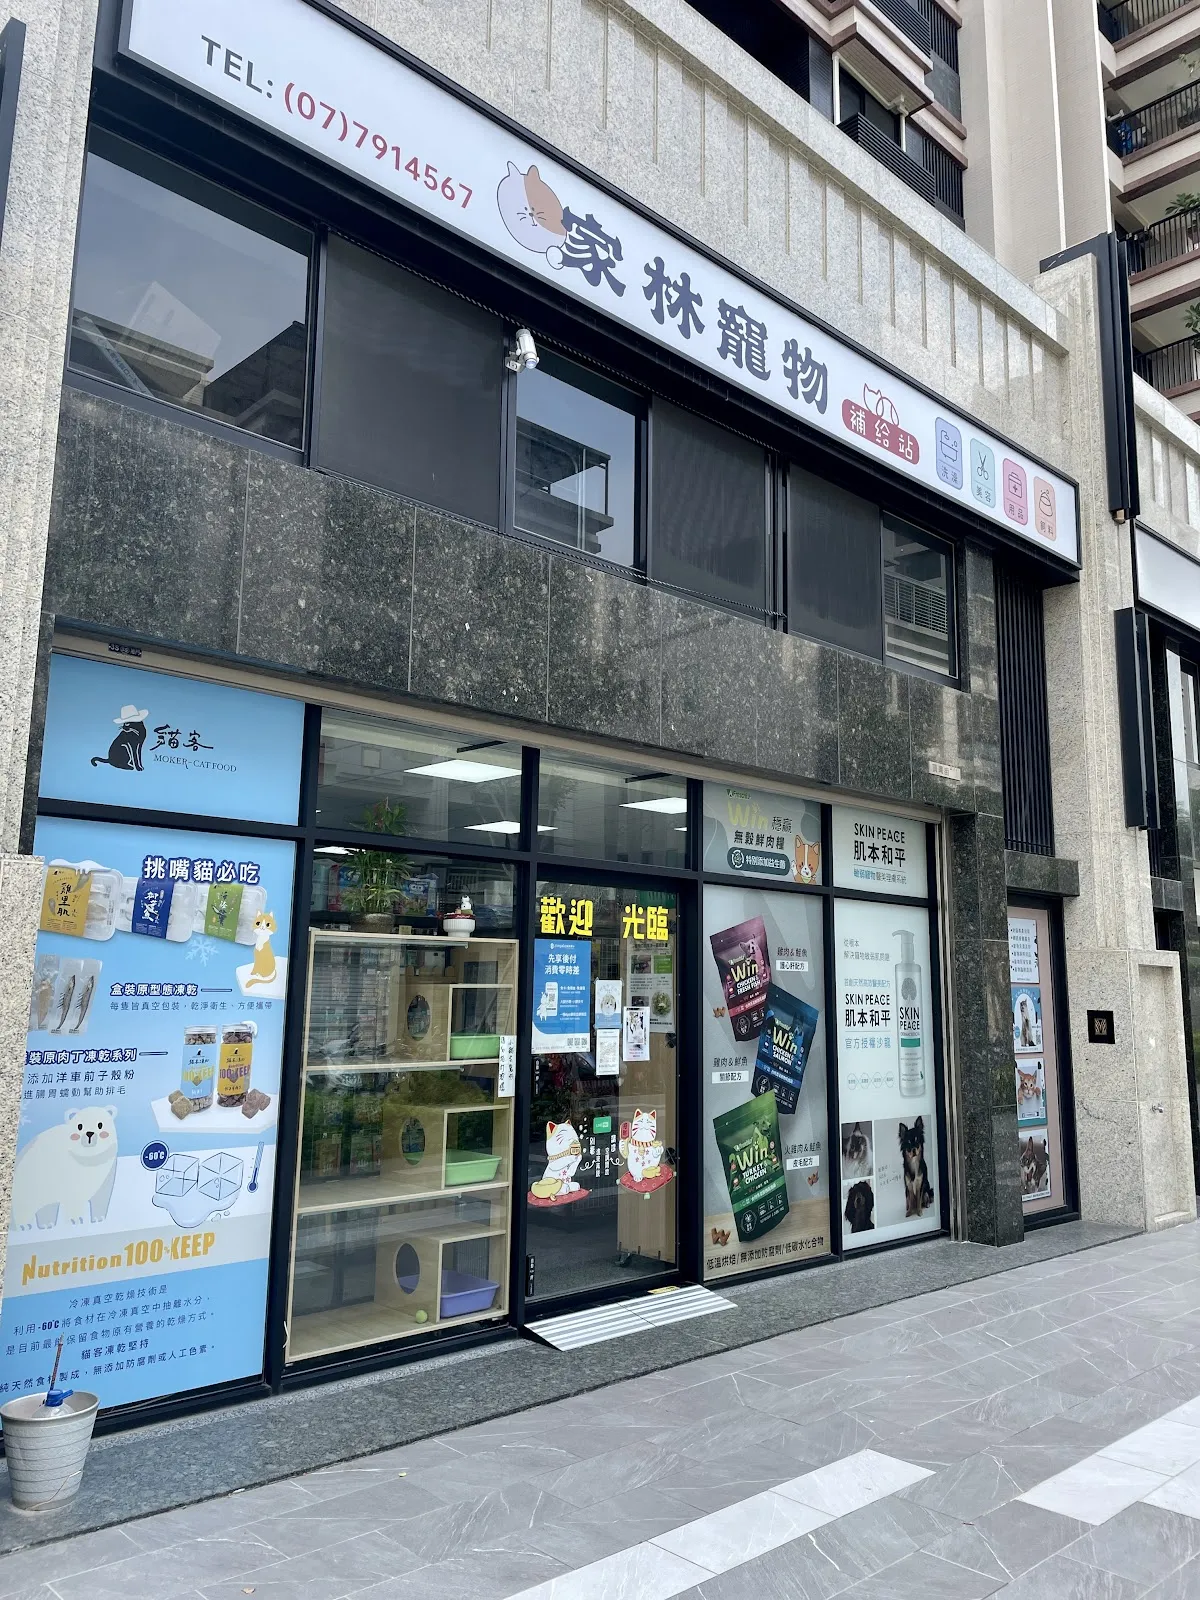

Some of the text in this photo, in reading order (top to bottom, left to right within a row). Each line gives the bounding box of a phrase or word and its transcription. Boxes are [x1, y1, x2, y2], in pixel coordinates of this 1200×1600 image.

[202, 35, 473, 209] TEL: (07)7914567
[561, 205, 828, 414] 家林寵物
[1008, 503, 1024, 520] 用品
[149, 723, 214, 752] 貓客
[728, 800, 768, 830] Win
[854, 823, 906, 844] SKIN PEACE
[853, 840, 906, 868] 肌本和平
[143, 855, 261, 885] 挑嘴貓必吃
[540, 896, 669, 941] 歡迎 光臨
[548, 953, 577, 964] 先享後付
[544, 965, 580, 975] 消費零時差
[730, 960, 759, 983] Win
[110, 982, 199, 998] 盒裝原型態凍乾
[845, 993, 891, 1006] SKIN PEACE
[845, 1009, 891, 1027] 肌本和平
[900, 1006, 920, 1020] SKIN
[900, 1020, 920, 1031] PEACE
[773, 1026, 798, 1054] Win
[24, 1048, 137, 1066] 裝原肉丁凍乾系列
[736, 1146, 768, 1171] Win
[742, 1163, 763, 1179] TURKEY
[745, 1167, 767, 1185] CHICKEN
[22, 1254, 122, 1286] Nutrition
[69, 1285, 168, 1310] 冷凍真空乾燥技術是
[81, 1339, 150, 1361] 貓客凍乾堅持
